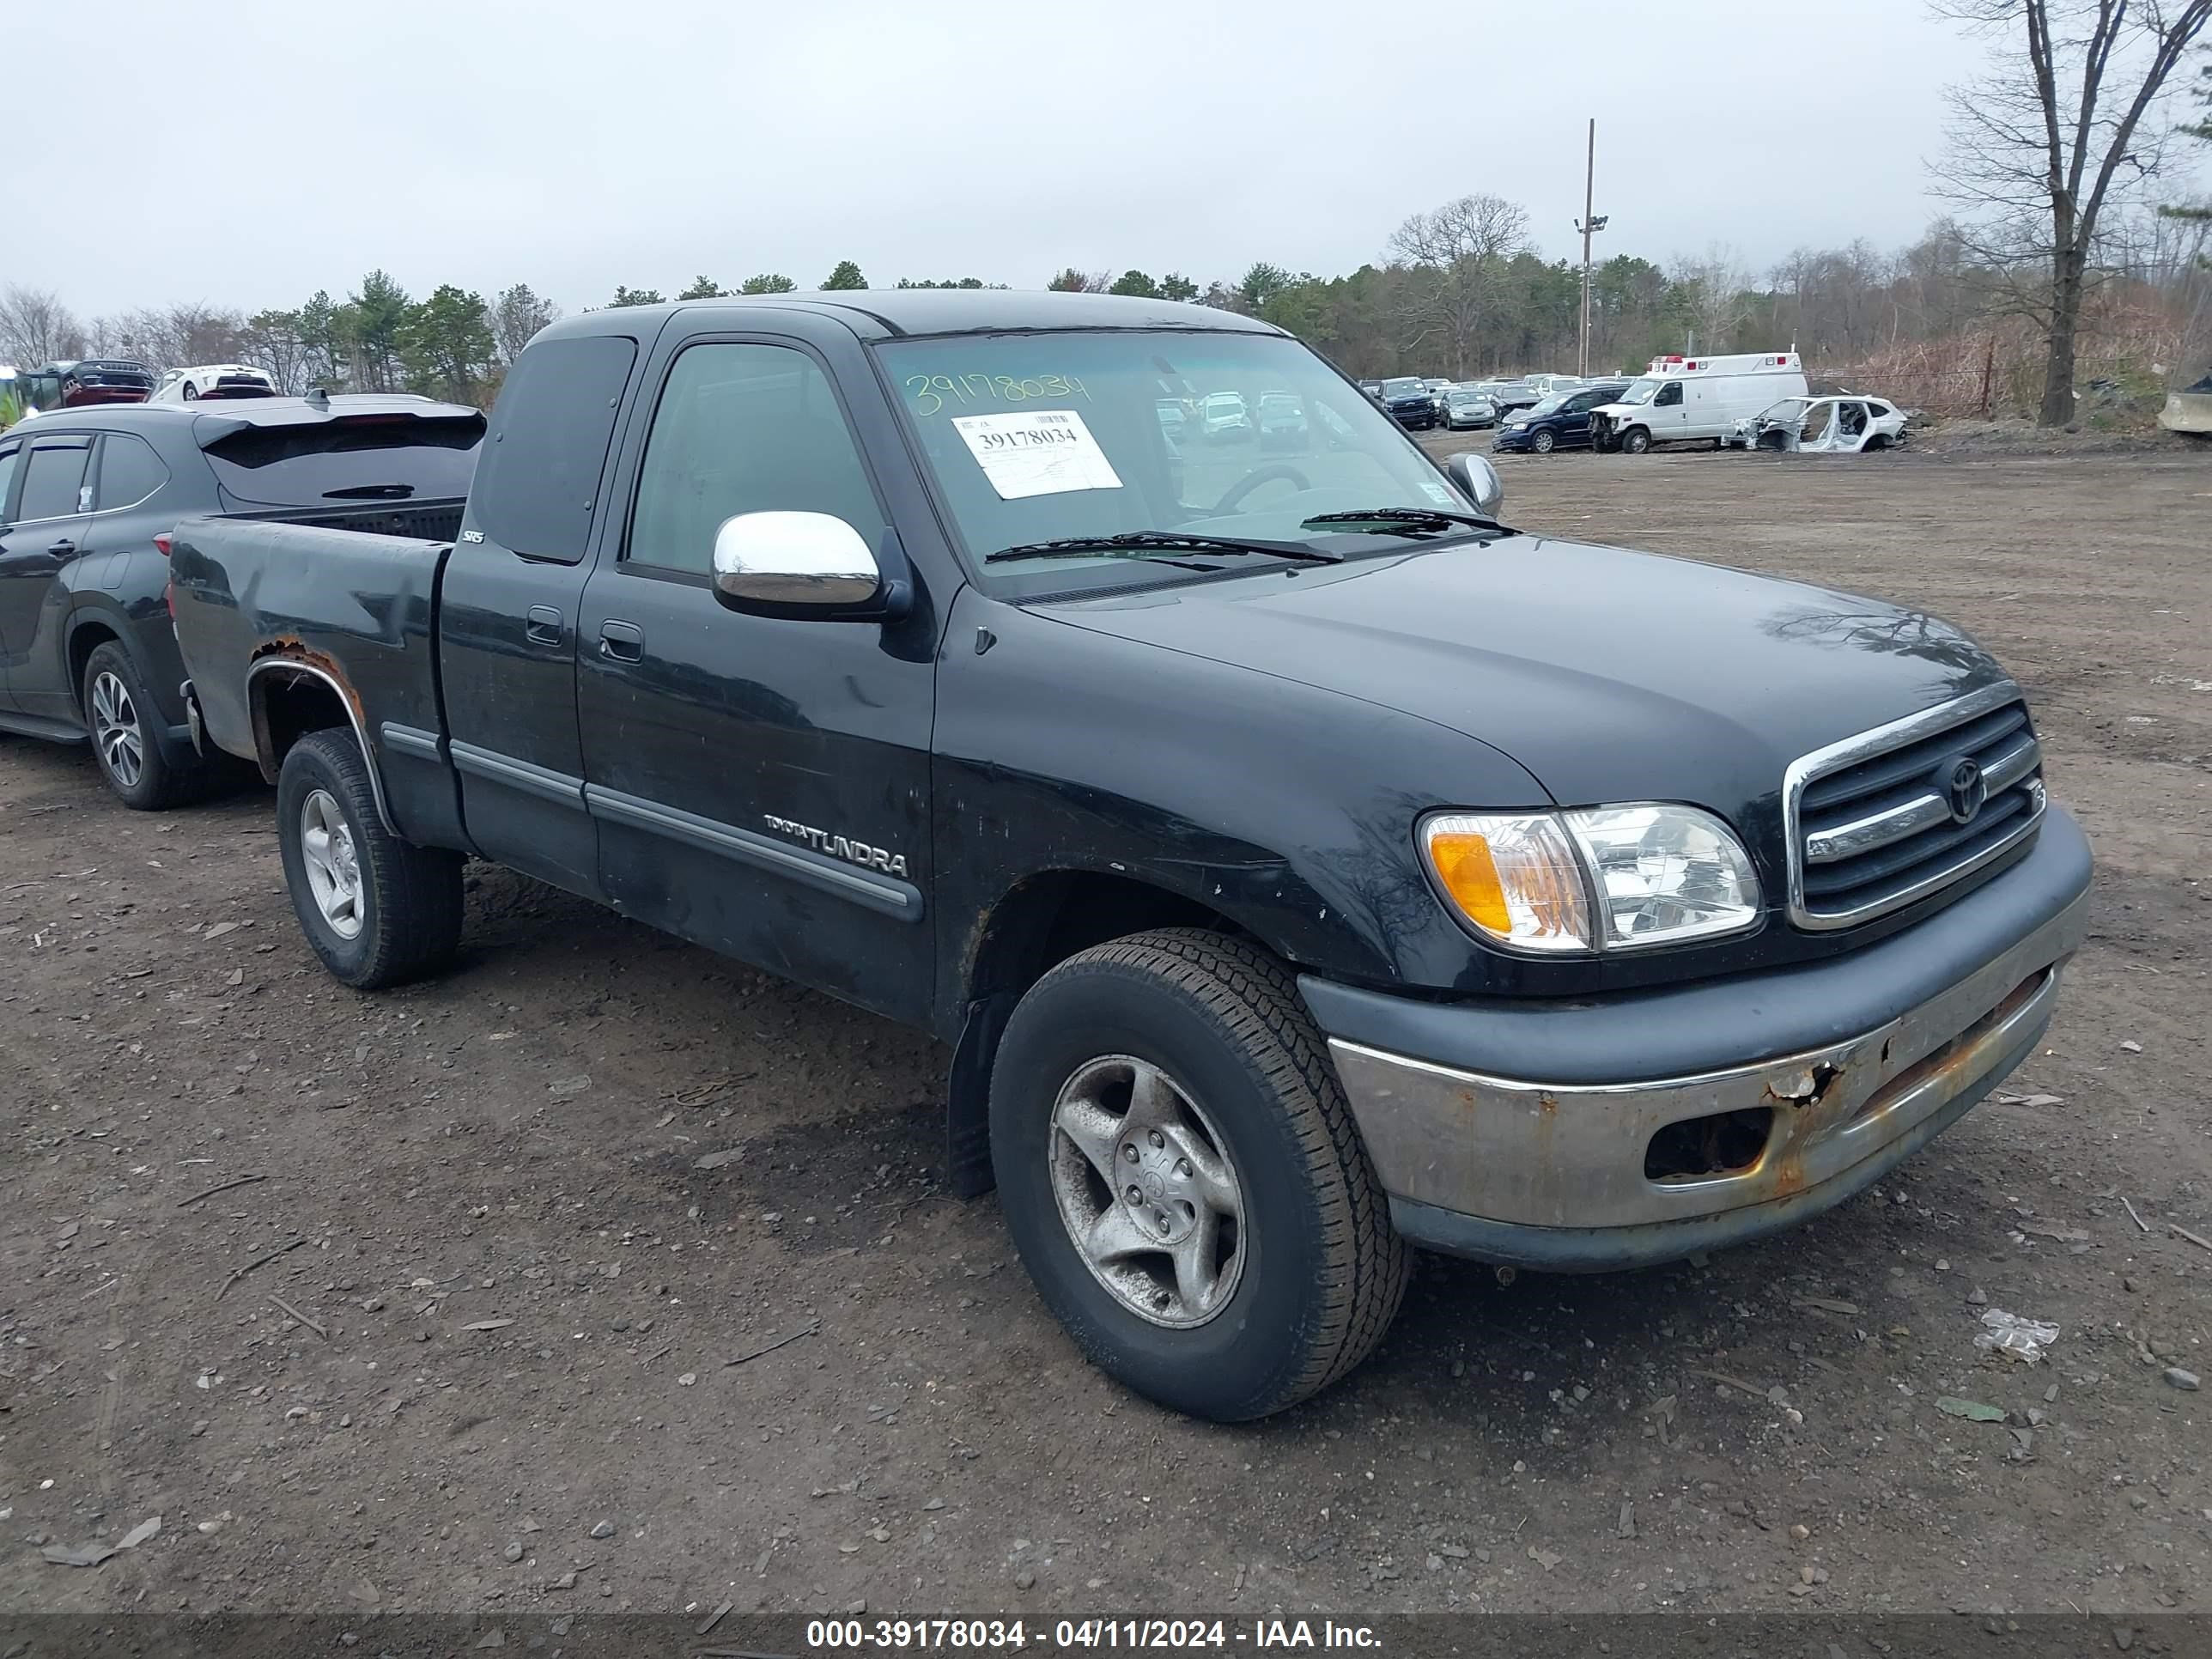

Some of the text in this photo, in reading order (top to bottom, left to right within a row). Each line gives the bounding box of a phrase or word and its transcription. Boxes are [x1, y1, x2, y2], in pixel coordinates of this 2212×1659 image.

[906, 374, 1091, 416] 39178034
[979, 428, 1078, 449] 39178034
[763, 814, 908, 878] TOYOTA TUNDRA
